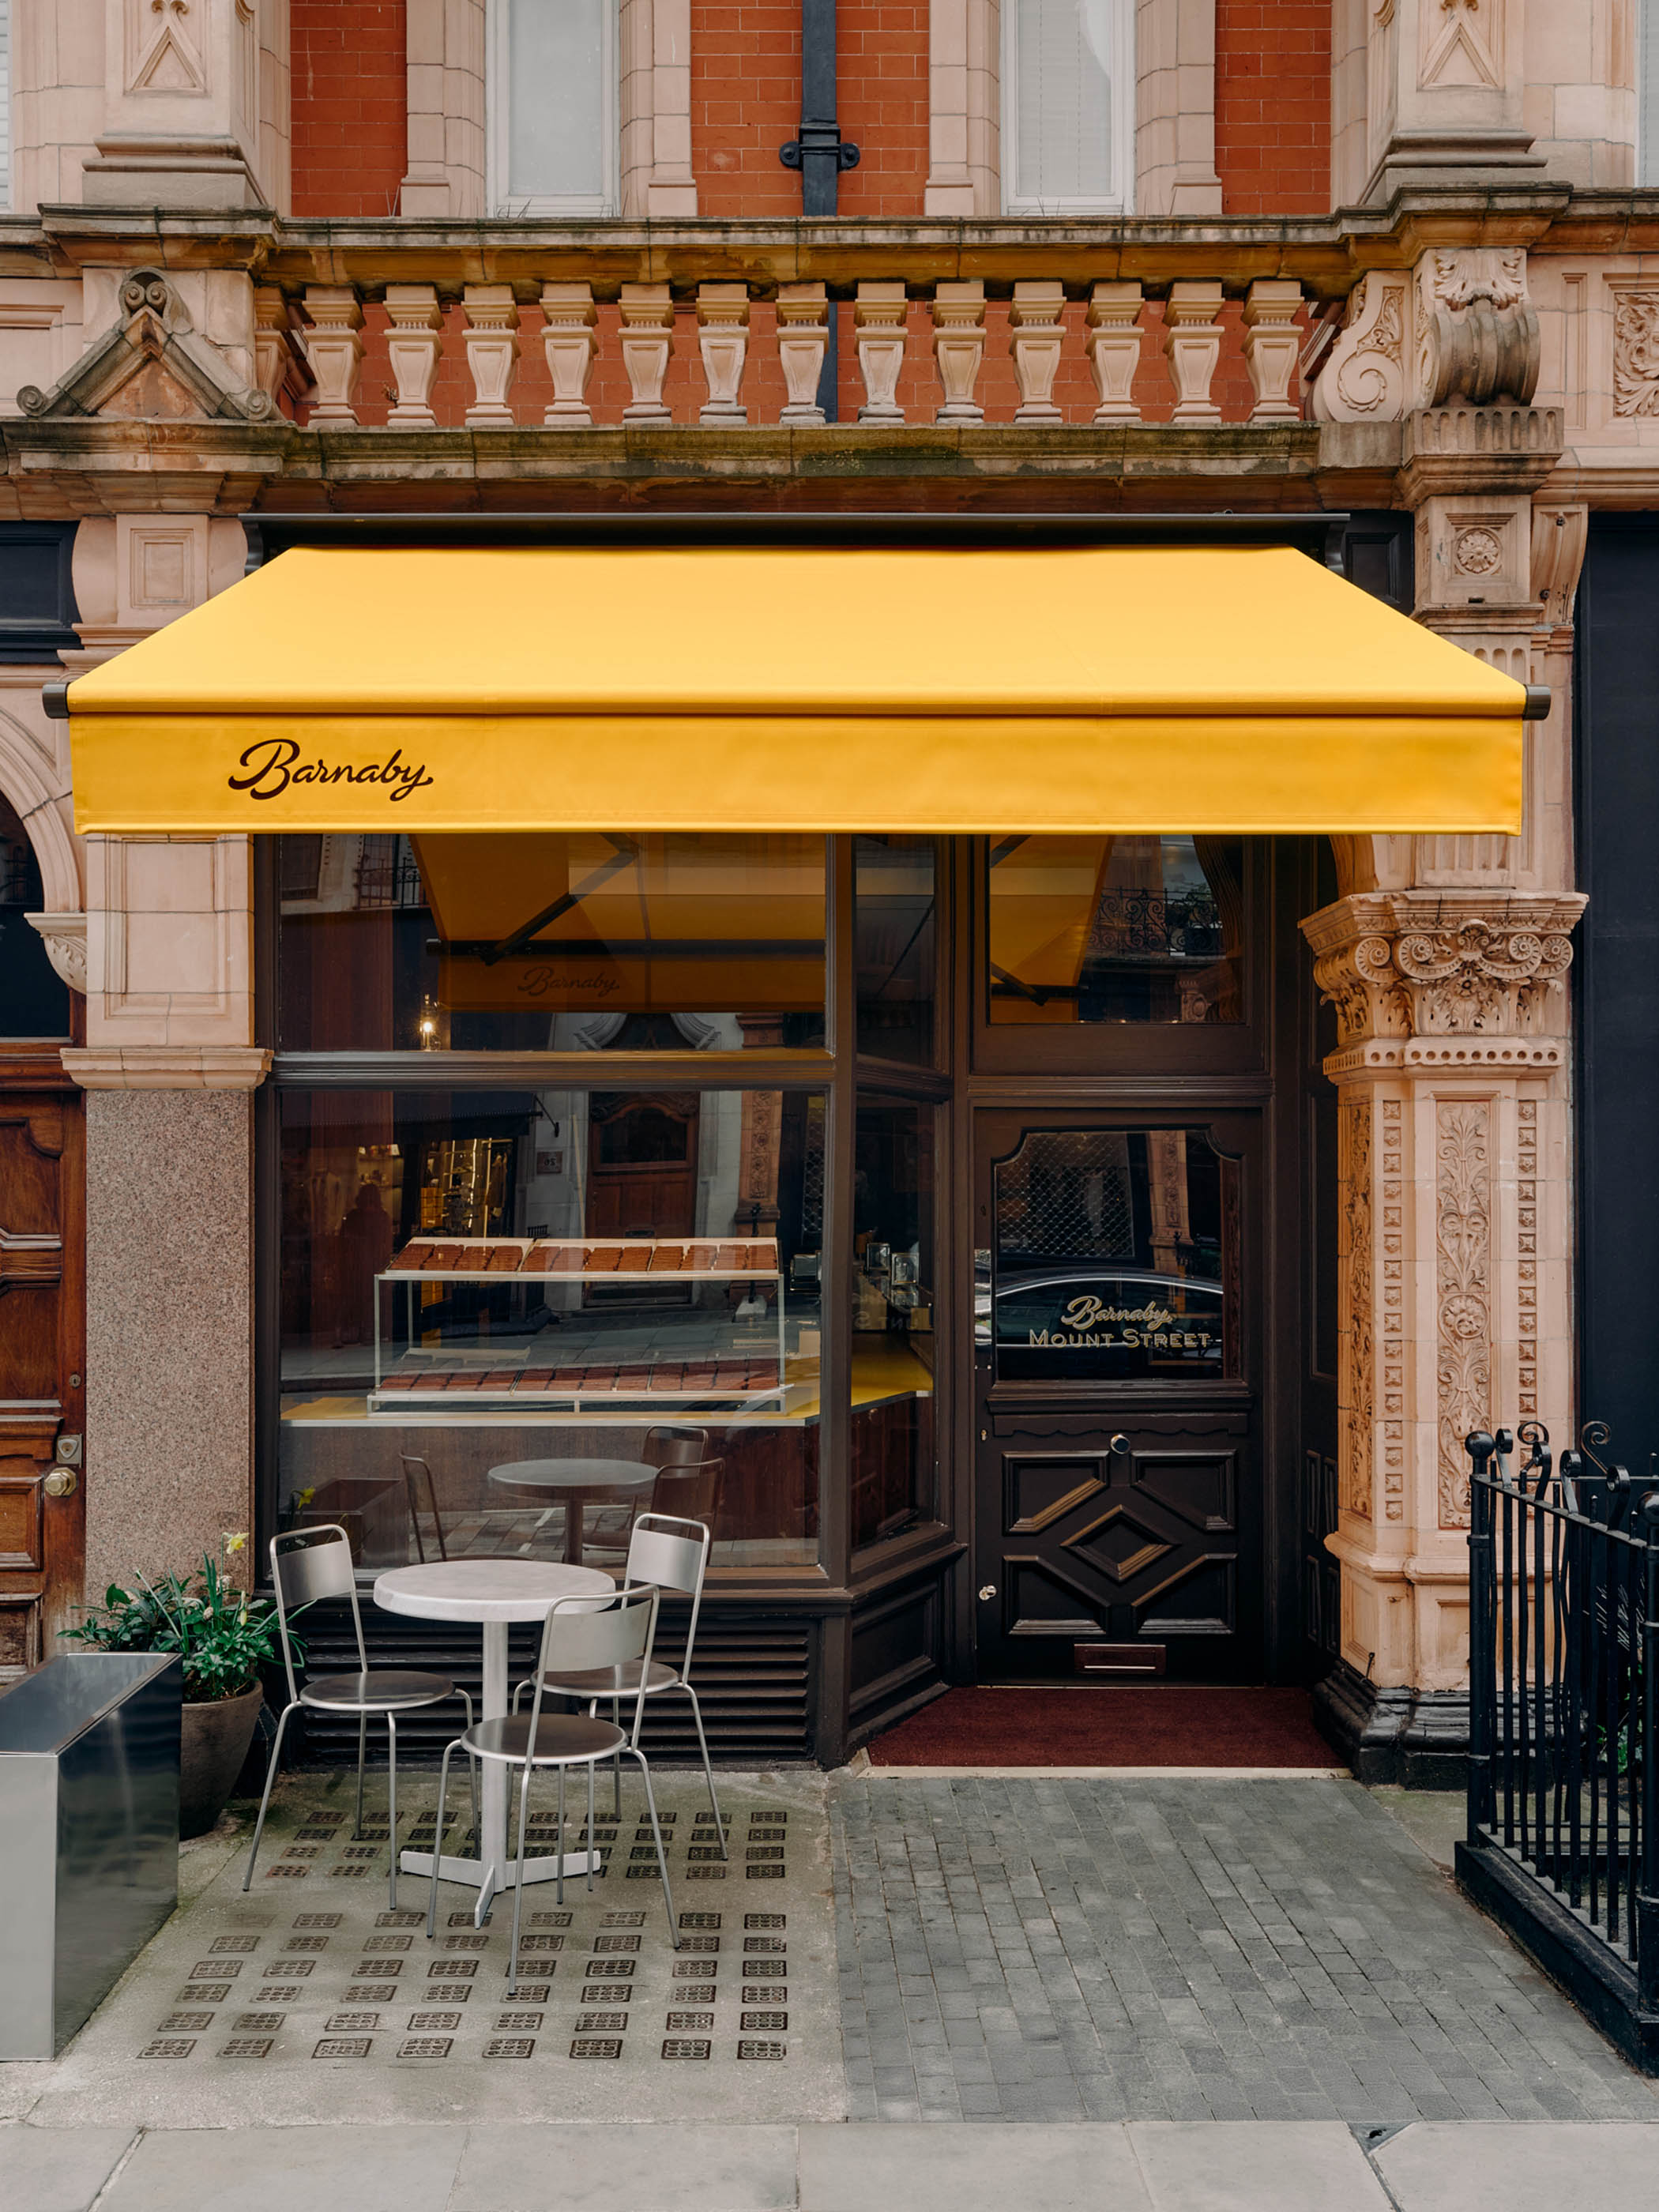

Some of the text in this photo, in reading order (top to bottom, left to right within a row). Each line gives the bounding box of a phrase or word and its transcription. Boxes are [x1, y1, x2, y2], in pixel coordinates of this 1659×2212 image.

[228, 738, 434, 802] Barnaby
[517, 965, 620, 998] Barnaby
[1061, 1295, 1173, 1331] Barnaby
[1029, 1328, 1211, 1349] MOUNT STREET
